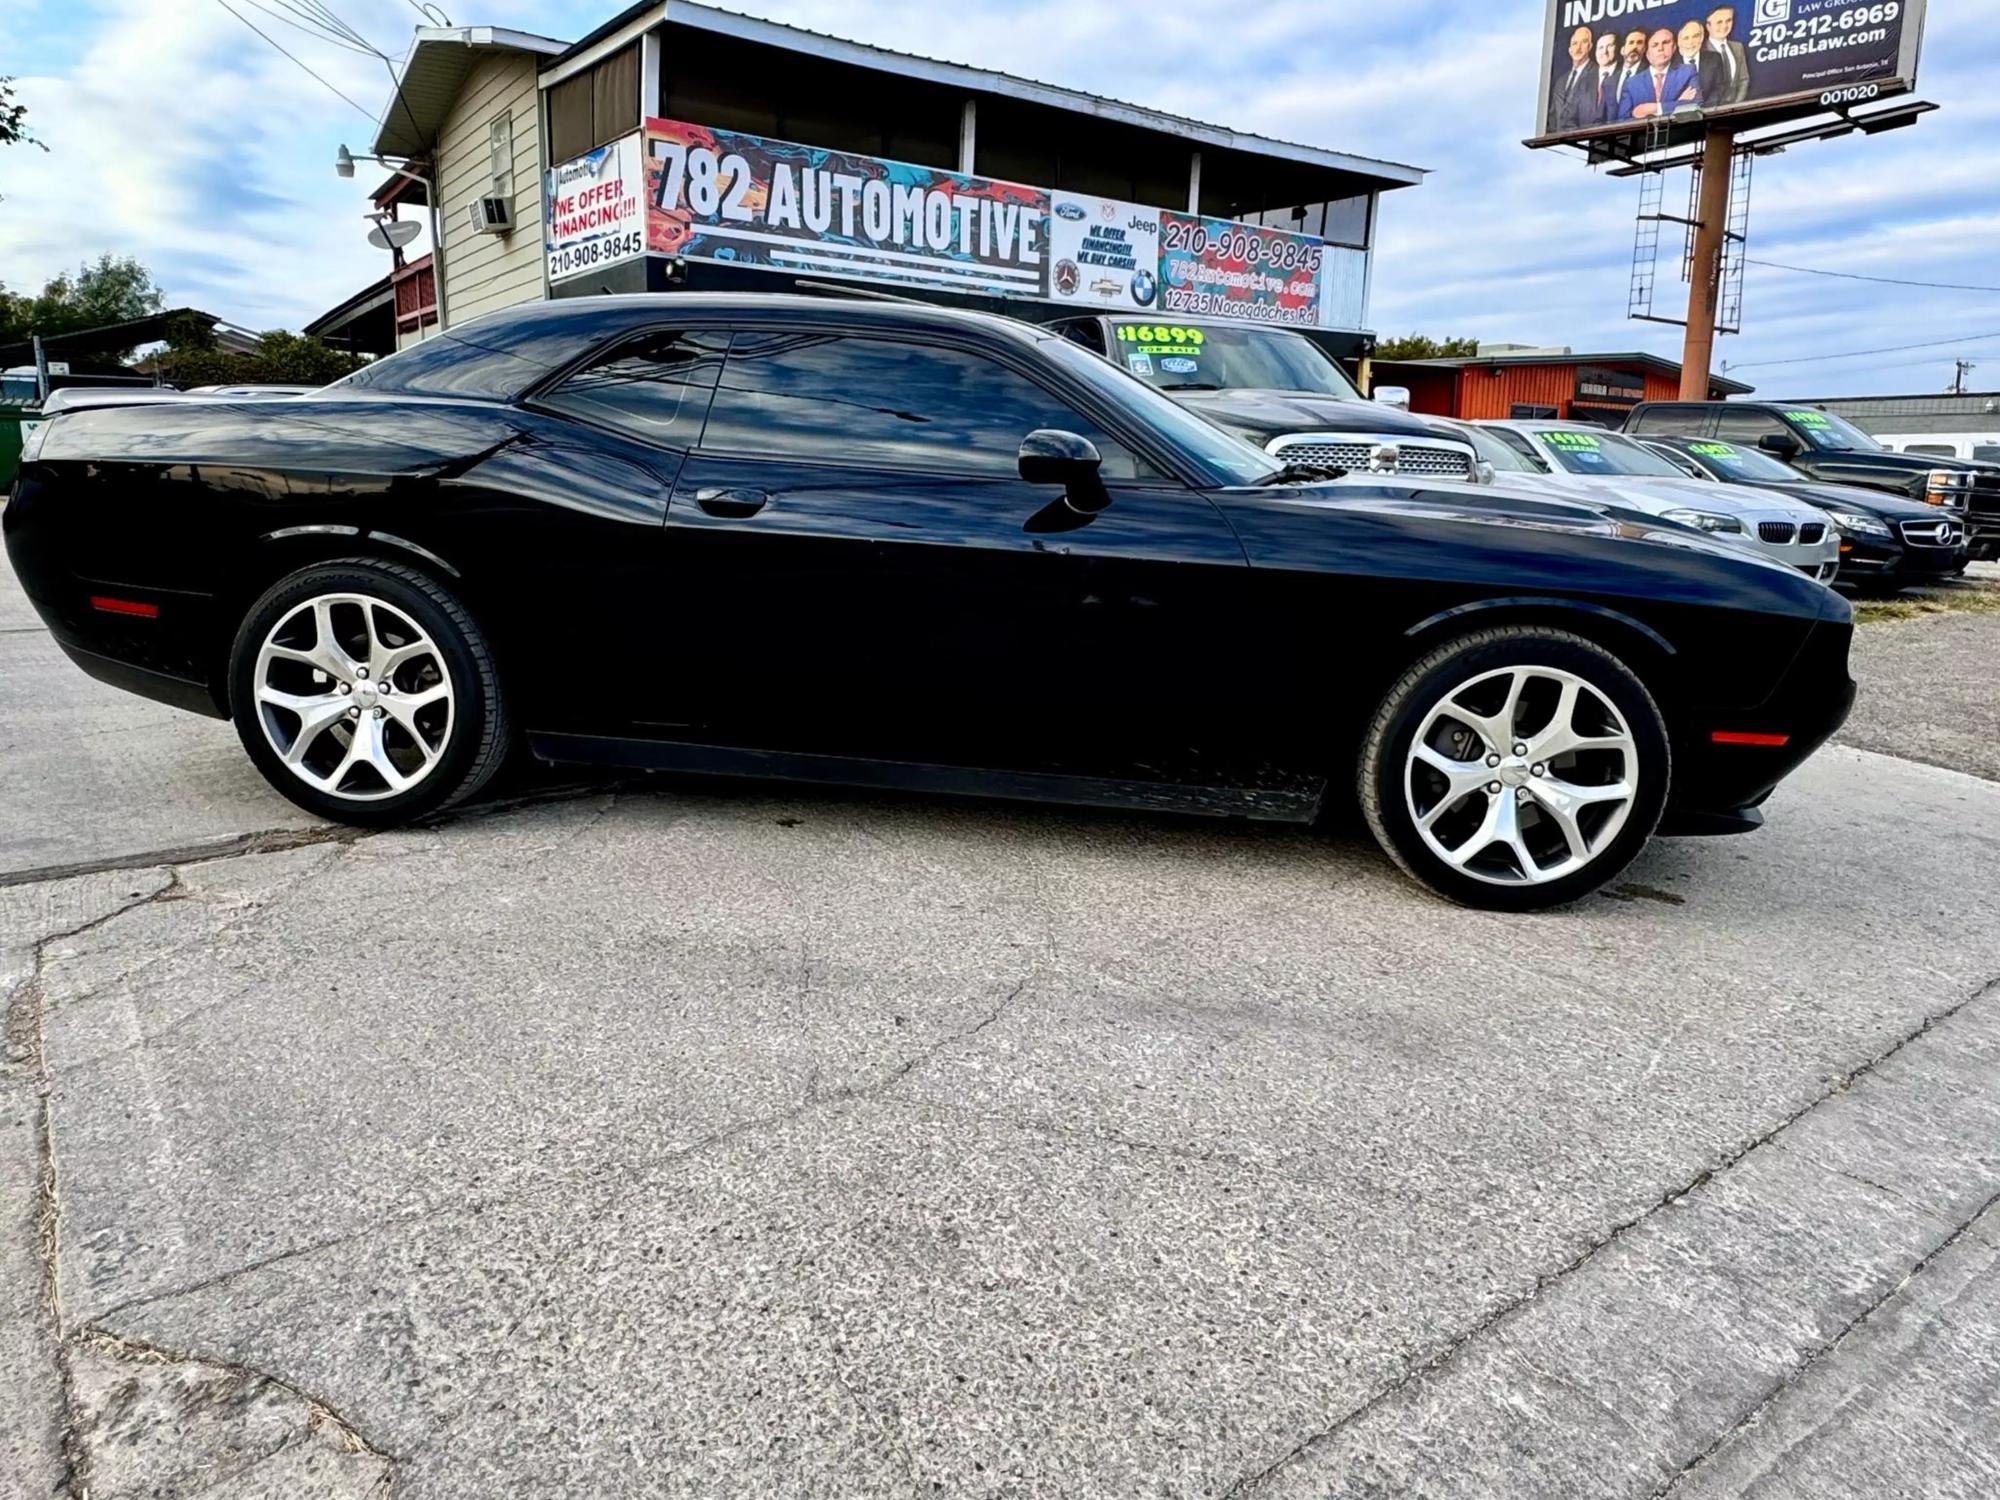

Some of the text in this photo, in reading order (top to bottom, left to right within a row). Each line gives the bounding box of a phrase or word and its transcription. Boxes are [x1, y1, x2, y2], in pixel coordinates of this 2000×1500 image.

[1797, 2, 1822, 14] LAW
[1748, 2, 1899, 47] 210-212-6969
[1756, 28, 1886, 62] CalfasLaw.com
[1820, 84, 1878, 105] 001020
[578, 179, 624, 209] OFFER
[650, 140, 1042, 264] 782 AUTOMOTIVE
[1060, 205, 1081, 219] Ford
[1128, 215, 1157, 235] Jeep
[1089, 224, 1126, 241] WE OFFER
[1166, 223, 1323, 272] 210-908-9845
[551, 231, 642, 275] 210-908-9845
[1077, 250, 1089, 263] WE
[1091, 253, 1106, 266] BUY
[1170, 259, 1316, 297] 782Automotive.com
[1166, 289, 1210, 312] 12735
[1298, 306, 1316, 323] Rd
[1116, 325, 1204, 344] $16899
